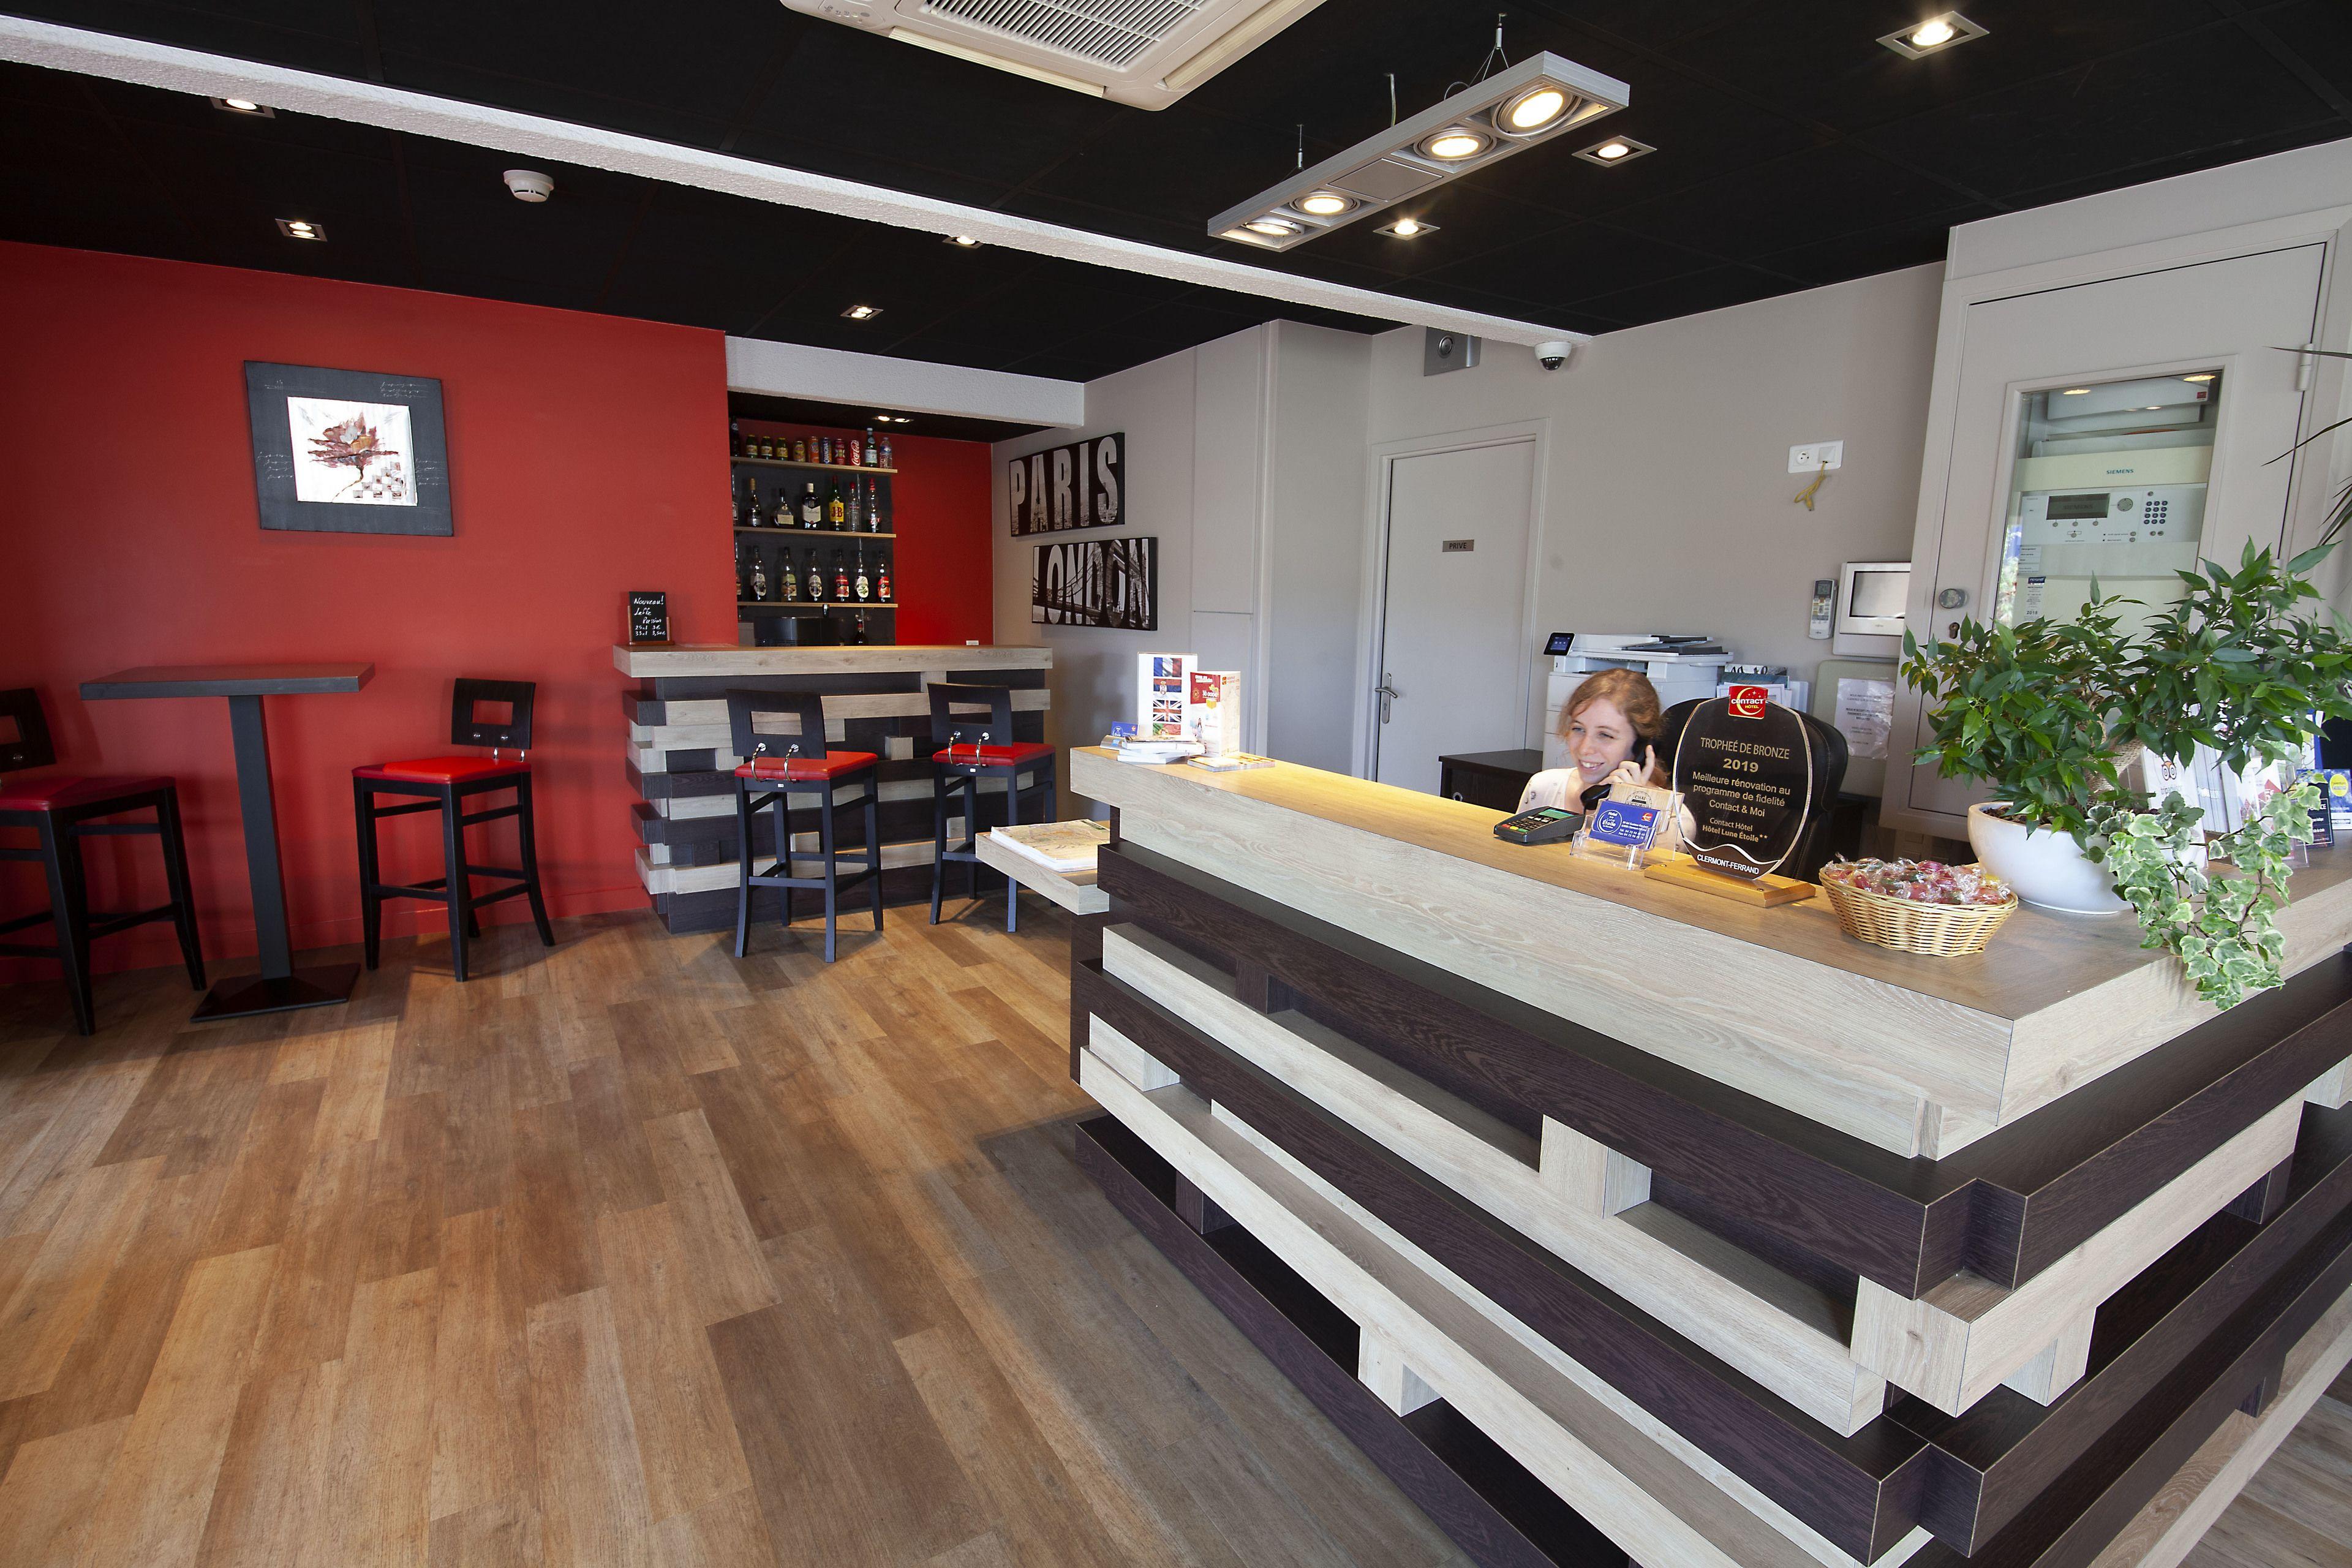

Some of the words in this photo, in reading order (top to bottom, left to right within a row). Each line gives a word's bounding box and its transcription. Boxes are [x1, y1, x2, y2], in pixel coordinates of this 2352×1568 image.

[1010, 436, 1118, 535] PARIS
[1032, 538, 1150, 628] LONDON
[1700, 737, 1738, 752] TROPHEÉ
[1740, 742, 1752, 754] DE
[1754, 744, 1790, 760] BRONZE
[1722, 758, 1758, 772] 2019
[1692, 771, 1730, 785] Meilleure
[1732, 778, 1777, 793] rénovation
[1693, 784, 1740, 799] programme
[1743, 792, 1754, 801] de
[1756, 794, 1785, 807] fidelité
[1709, 799, 1740, 812] Contact
[1741, 805, 1748, 814] &
[1750, 806, 1765, 817] Moi
[1702, 824, 1721, 834] Hôtel
[1721, 828, 1738, 838] Lune
[1709, 817, 1735, 828] Contact
[1735, 822, 1753, 832] Hôtel
[1697, 854, 1759, 875] CLERMONT-FERRAND
